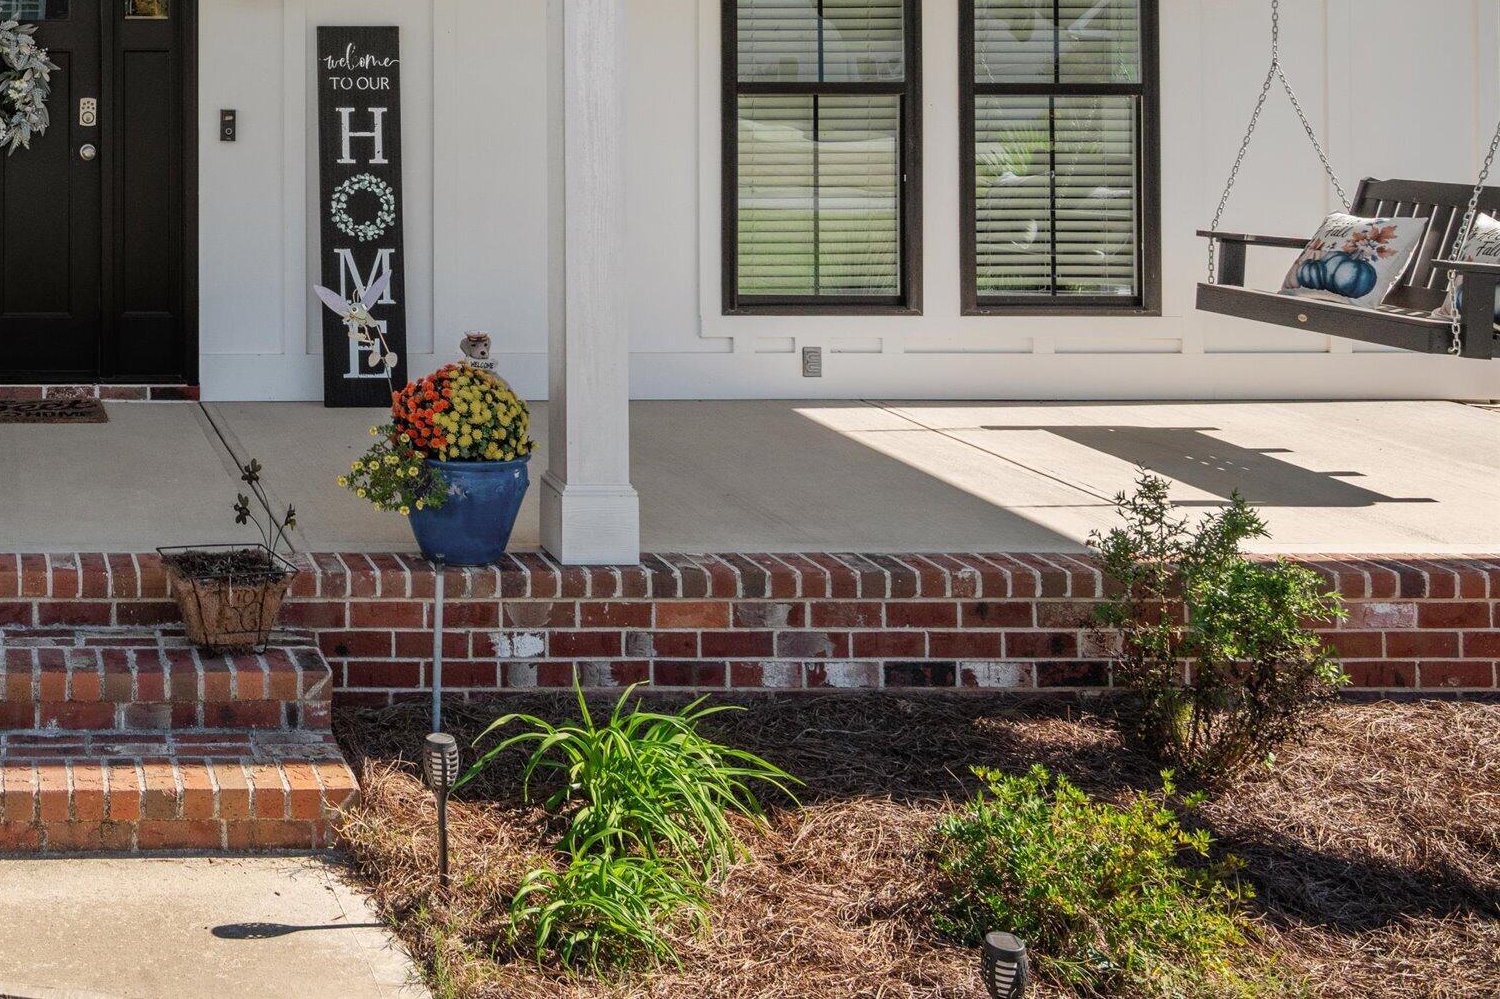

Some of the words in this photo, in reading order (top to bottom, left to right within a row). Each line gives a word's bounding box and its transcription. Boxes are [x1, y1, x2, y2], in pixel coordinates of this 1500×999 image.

[328, 77, 353, 90] TO
[356, 76, 390, 90] OUR
[470, 361, 494, 369] WELCOME
